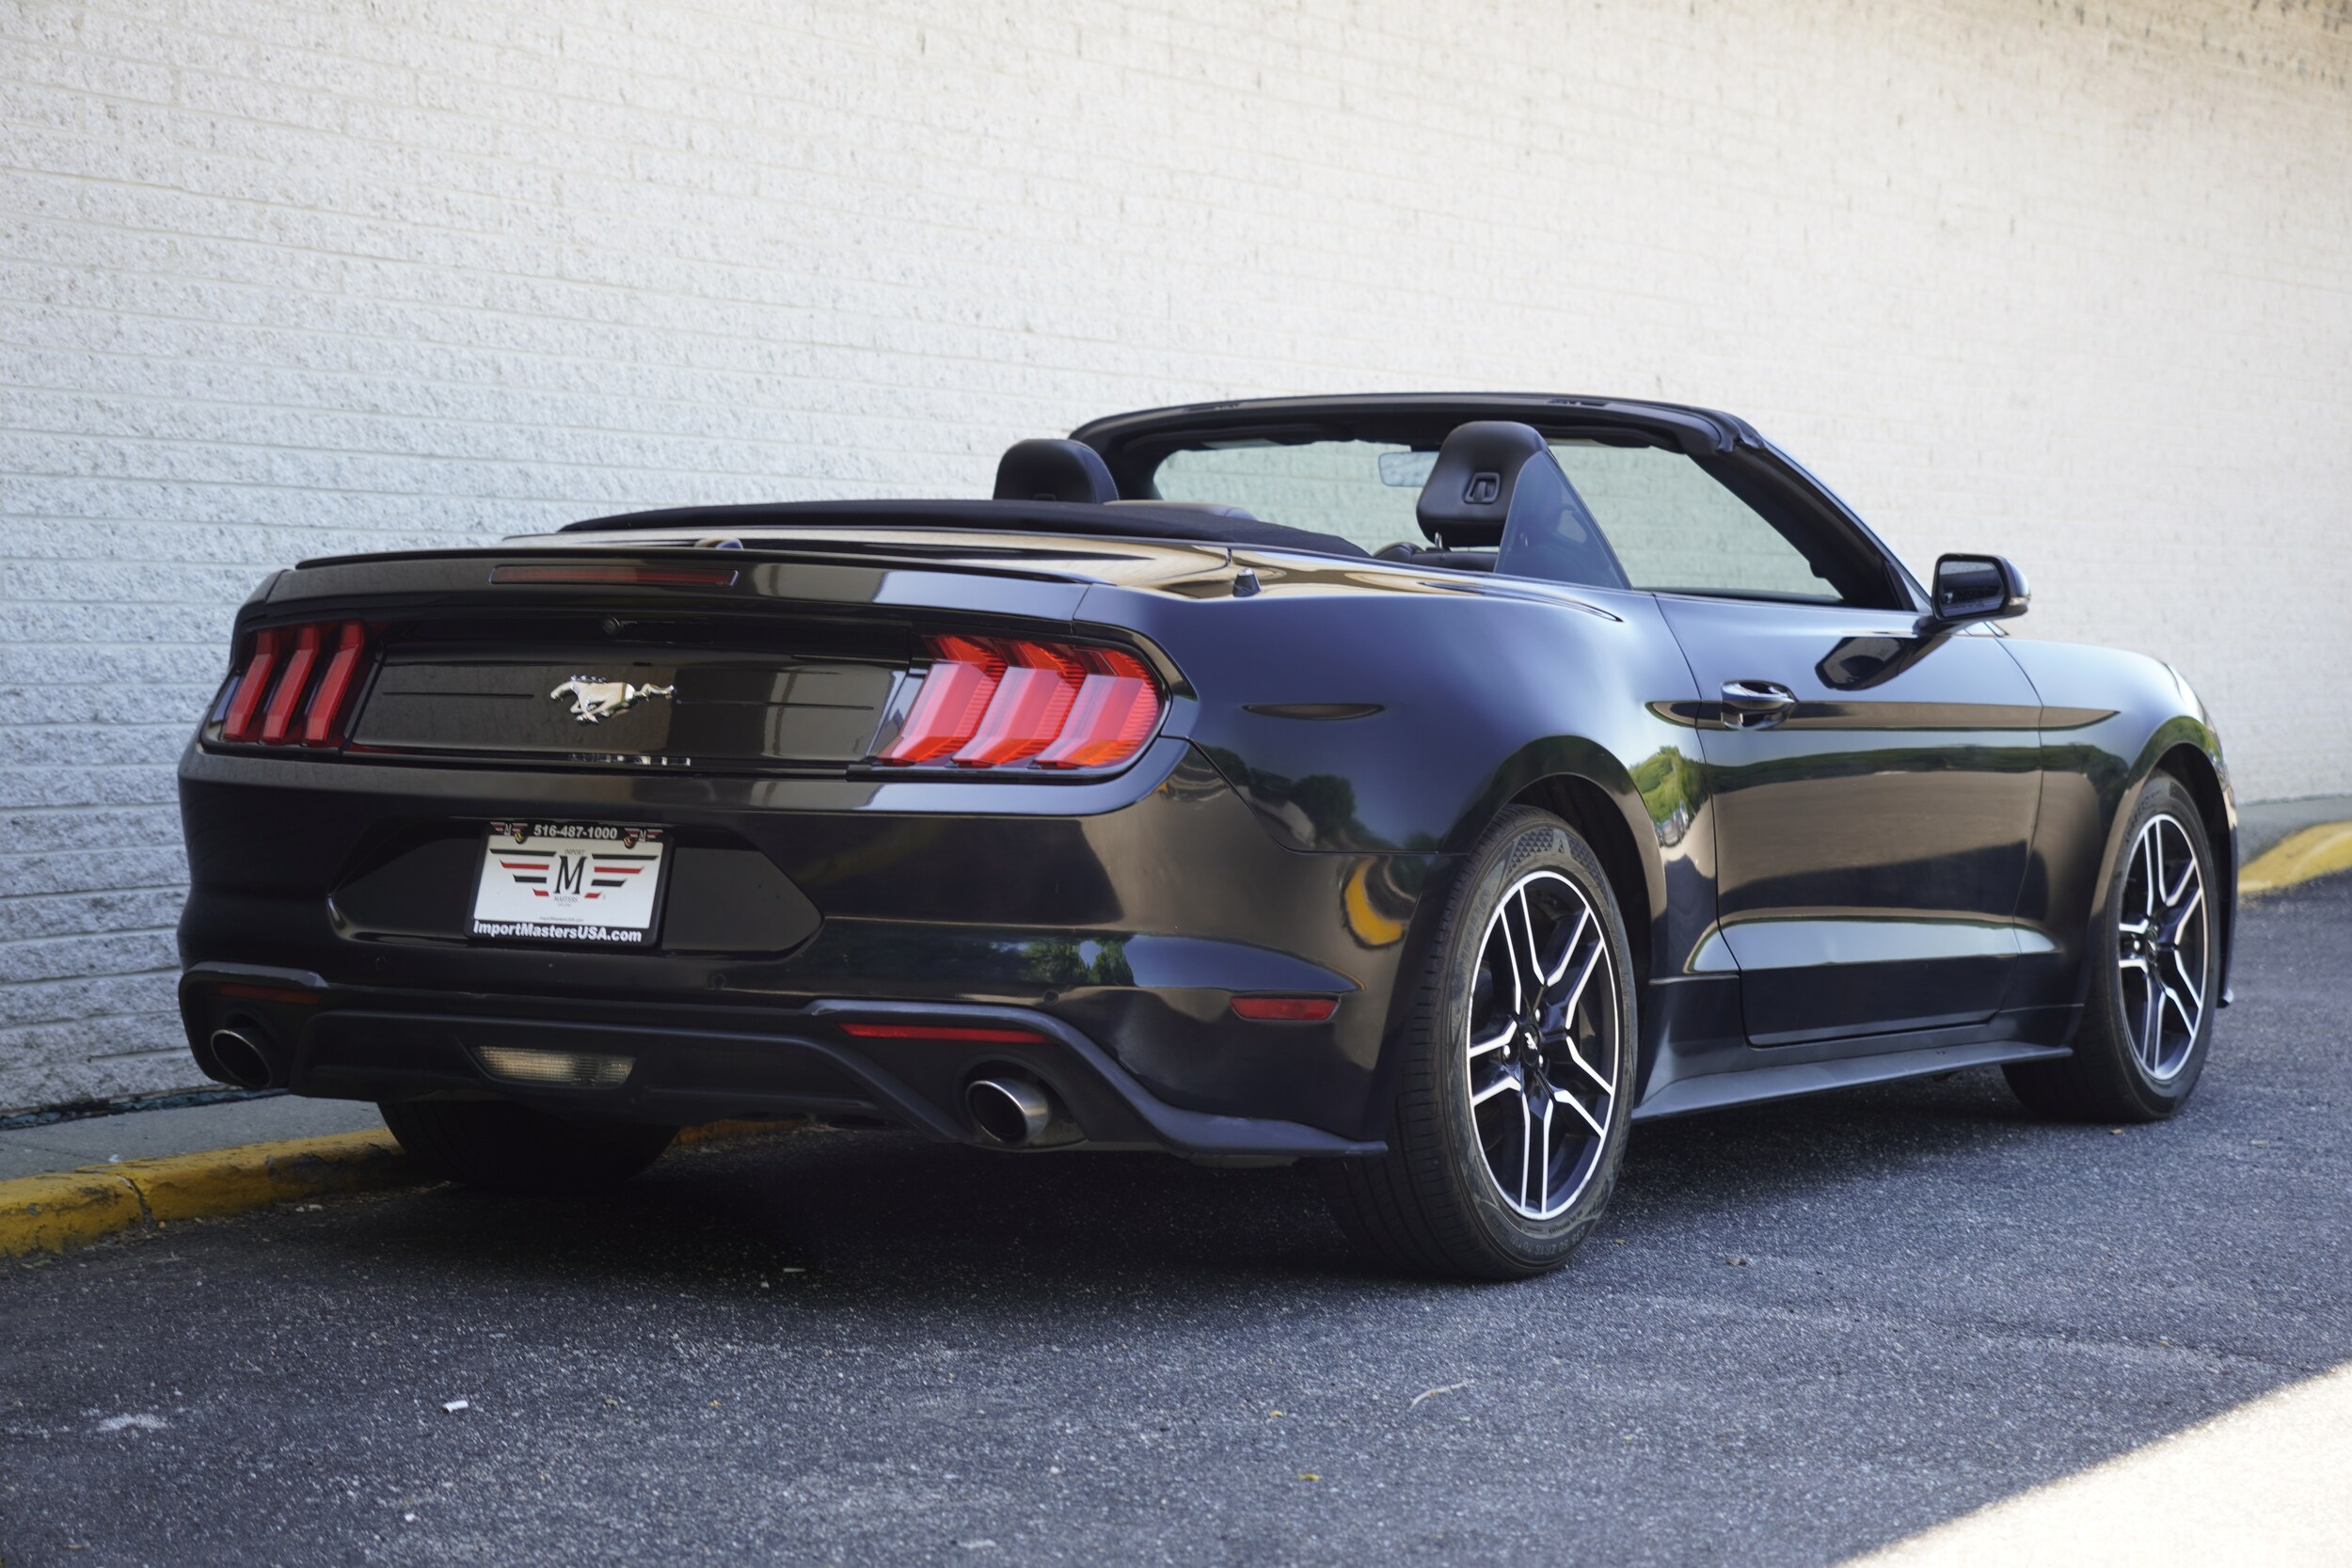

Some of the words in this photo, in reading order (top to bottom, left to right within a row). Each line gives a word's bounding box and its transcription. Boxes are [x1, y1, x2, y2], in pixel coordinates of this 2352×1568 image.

[533, 824, 618, 840] 516-487-1000
[553, 854, 588, 895] M
[472, 920, 643, 942] ImportMastersUSA.com
